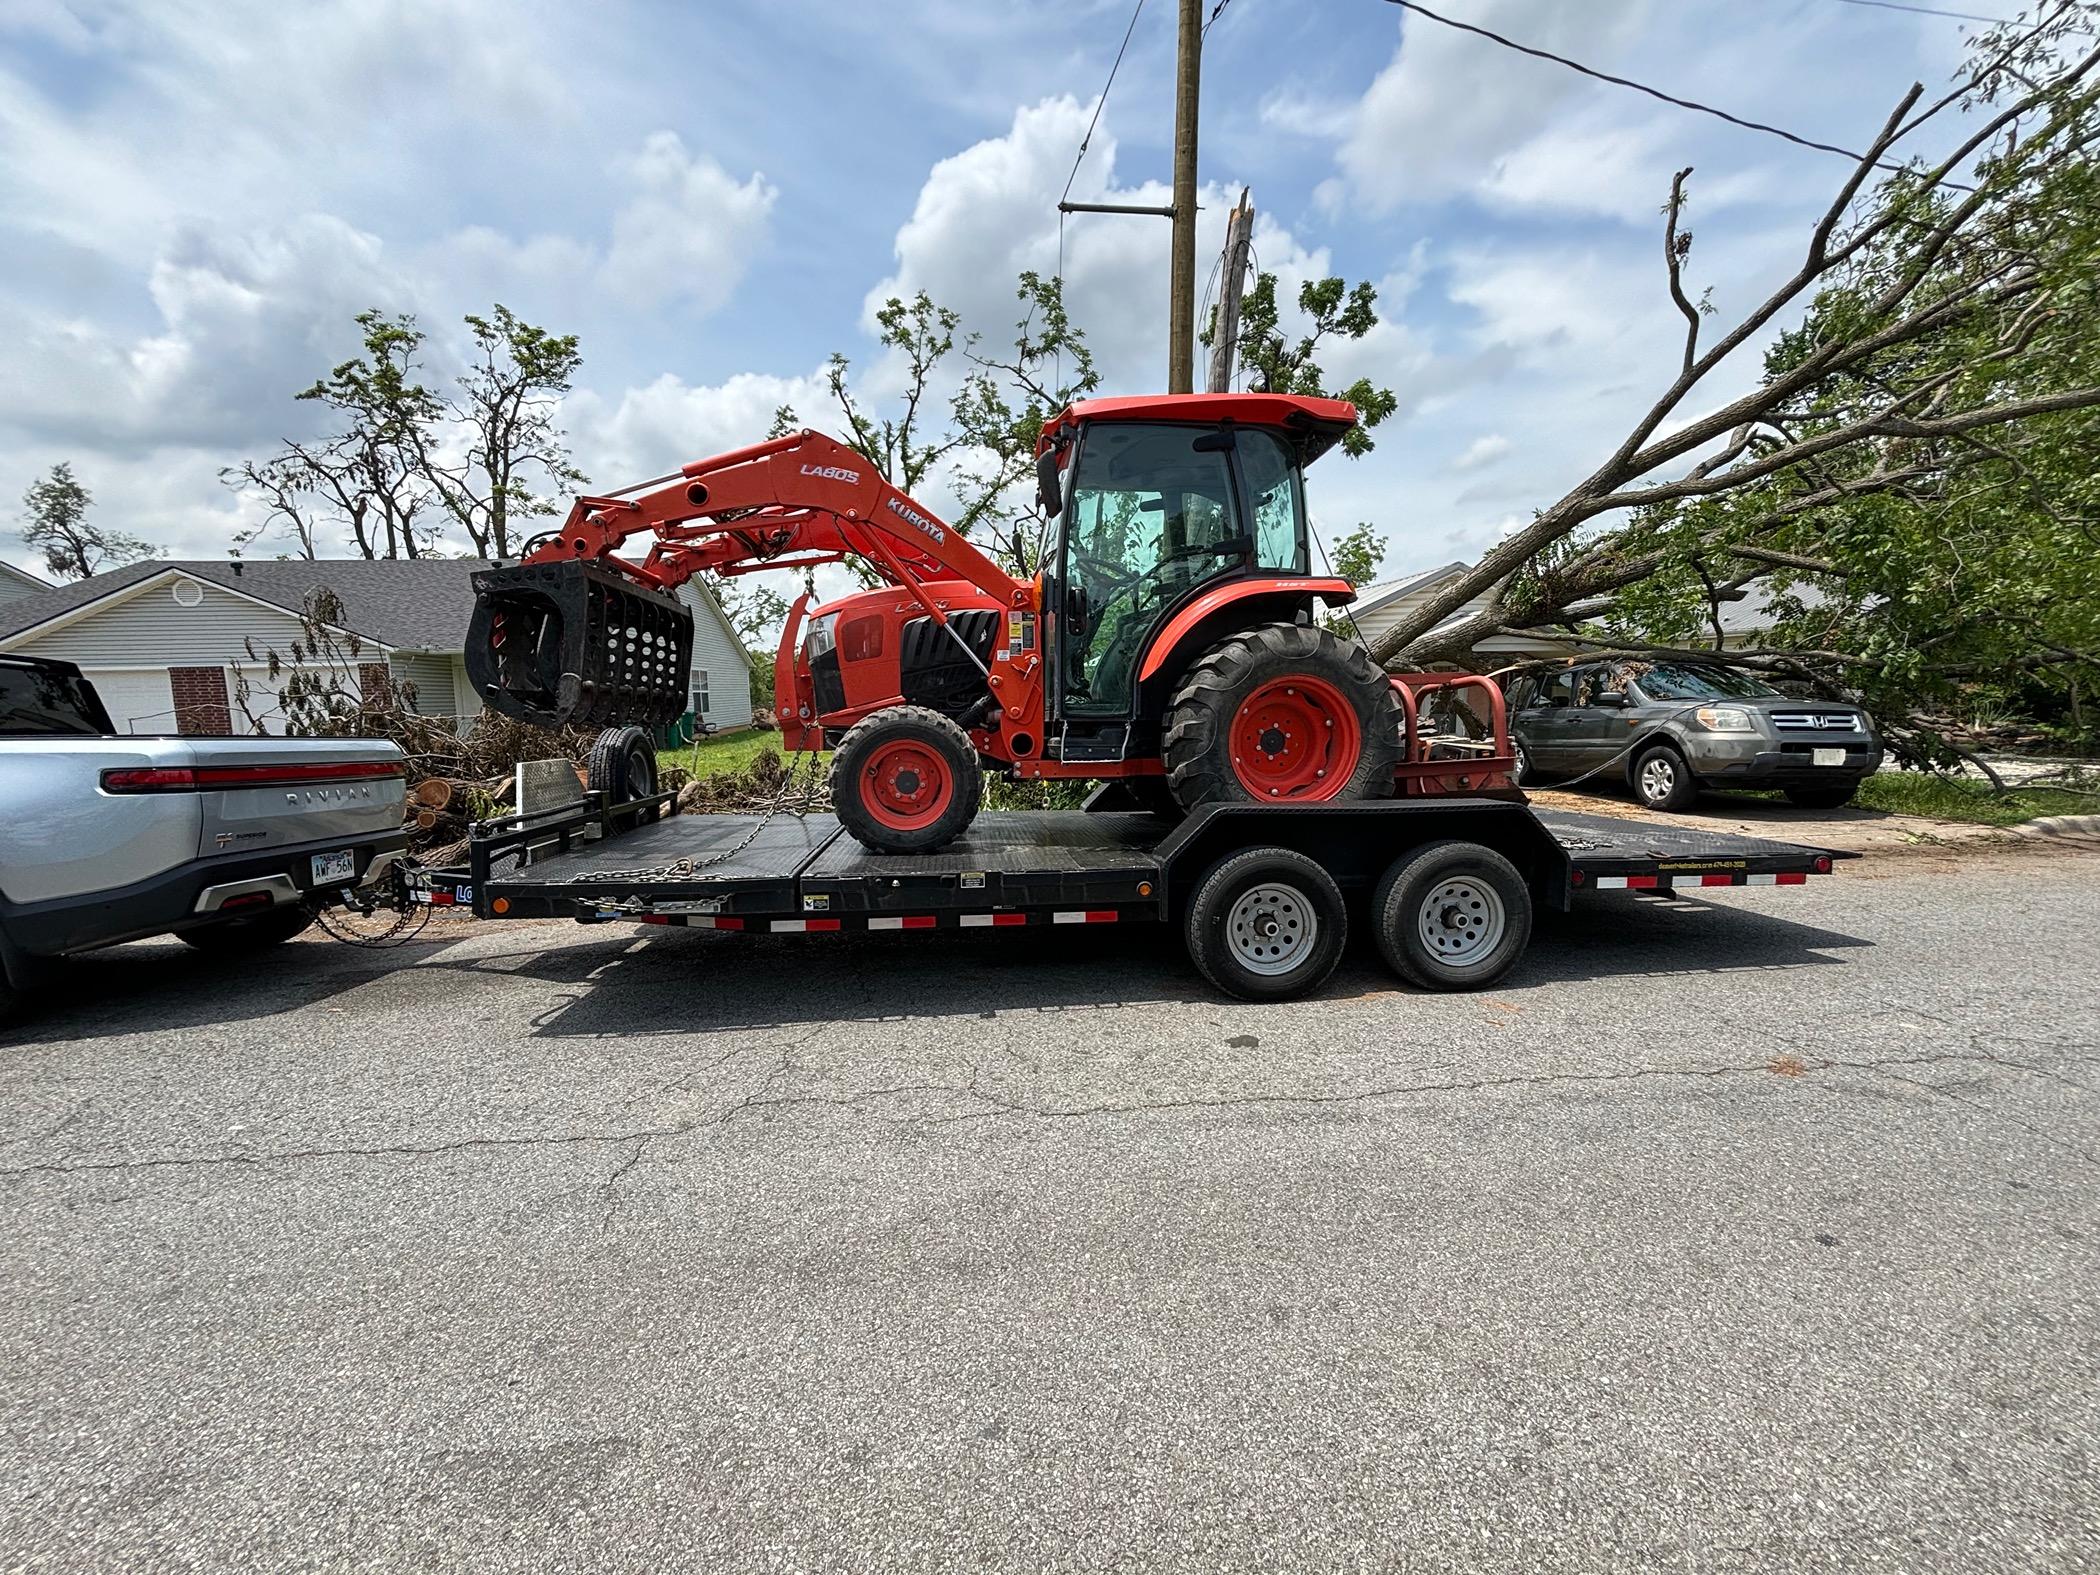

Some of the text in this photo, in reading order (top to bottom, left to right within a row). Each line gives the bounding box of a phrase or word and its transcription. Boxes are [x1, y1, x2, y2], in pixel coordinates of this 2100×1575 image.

[800, 464, 861, 485] LA805
[886, 497, 945, 545] KUBOTA
[286, 786, 370, 806] RIVIAN
[315, 861, 332, 878] AWF
[336, 857, 353, 873] 56N
